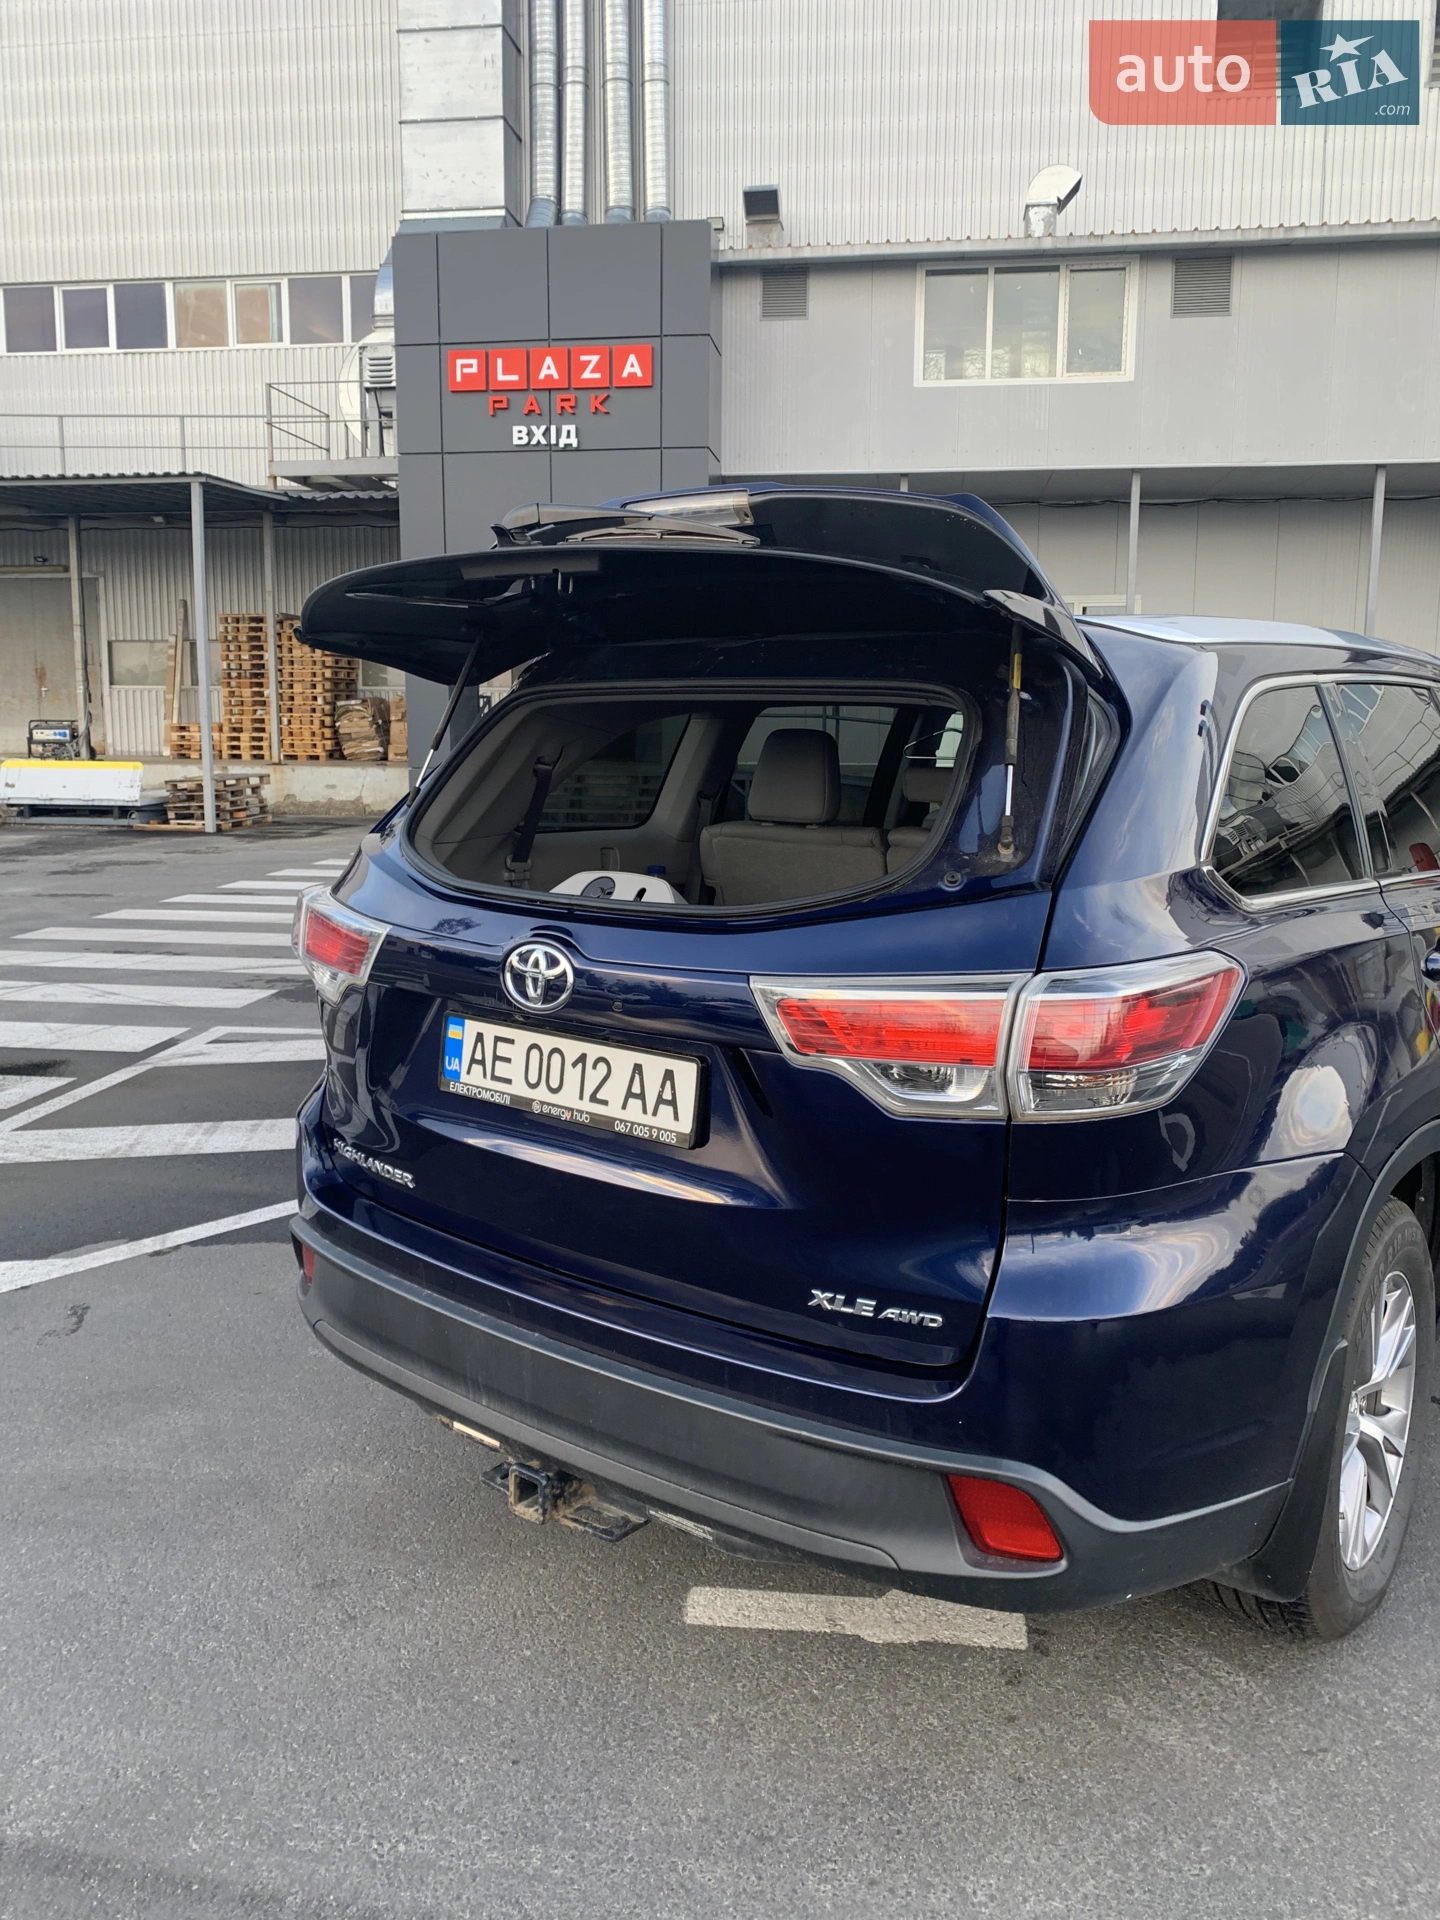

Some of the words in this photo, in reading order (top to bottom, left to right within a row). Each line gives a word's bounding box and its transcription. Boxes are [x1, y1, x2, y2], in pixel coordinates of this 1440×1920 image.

[454, 351, 645, 384] PLAZA
[488, 392, 610, 416] PARK
[512, 424, 578, 448] ВХІД
[445, 1056, 461, 1072] UA
[466, 1031, 515, 1086] AE
[524, 1042, 613, 1107] 0012
[620, 1062, 680, 1122] AA
[449, 1081, 511, 1105] ЕЛЕКТРОМОБІЛІ
[542, 1103, 572, 1121] energy
[573, 1109, 591, 1123] hub
[614, 1120, 631, 1132] 067
[632, 1124, 650, 1138] 005
[651, 1128, 658, 1139] 9
[659, 1130, 677, 1144] 005
[333, 1138, 416, 1189] HIGHLANDER
[807, 1288, 877, 1317] XLE
[877, 1306, 943, 1328] AWD
